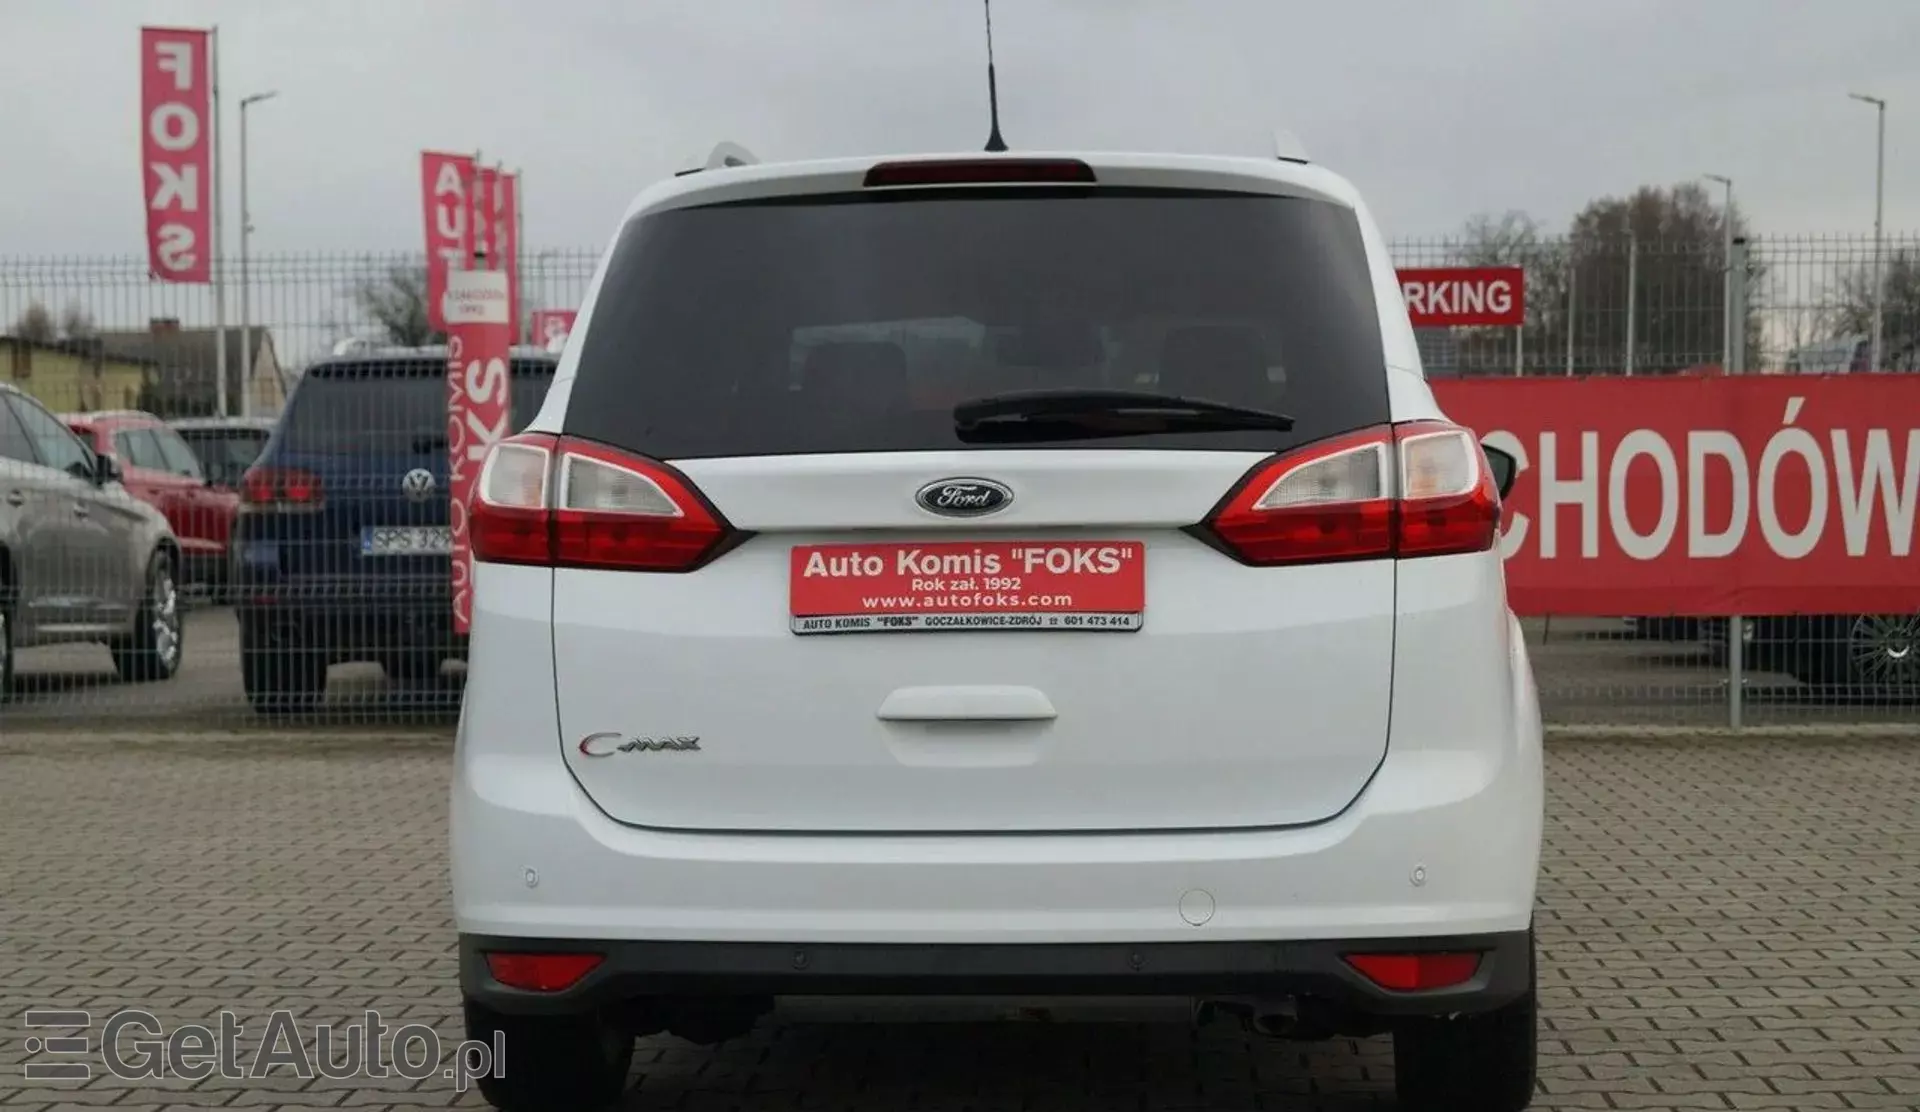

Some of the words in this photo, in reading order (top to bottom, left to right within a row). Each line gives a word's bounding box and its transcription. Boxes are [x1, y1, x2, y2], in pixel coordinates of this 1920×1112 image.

[1403, 280, 1512, 314] RKING
[937, 485, 991, 506] Ford
[803, 551, 884, 578] Auto
[897, 548, 1001, 576] Komis
[1011, 547, 1133, 575] "FOKS"
[912, 578, 946, 592] Rok
[950, 577, 979, 591] zał.
[984, 577, 1022, 591] 1992
[862, 592, 1072, 609] www.autofoks.com
[803, 618, 833, 630] AUTO
[835, 617, 871, 629] KOMIS
[1064, 615, 1084, 626] 601
[1088, 615, 1107, 626] 473
[1110, 615, 1131, 626] 414
